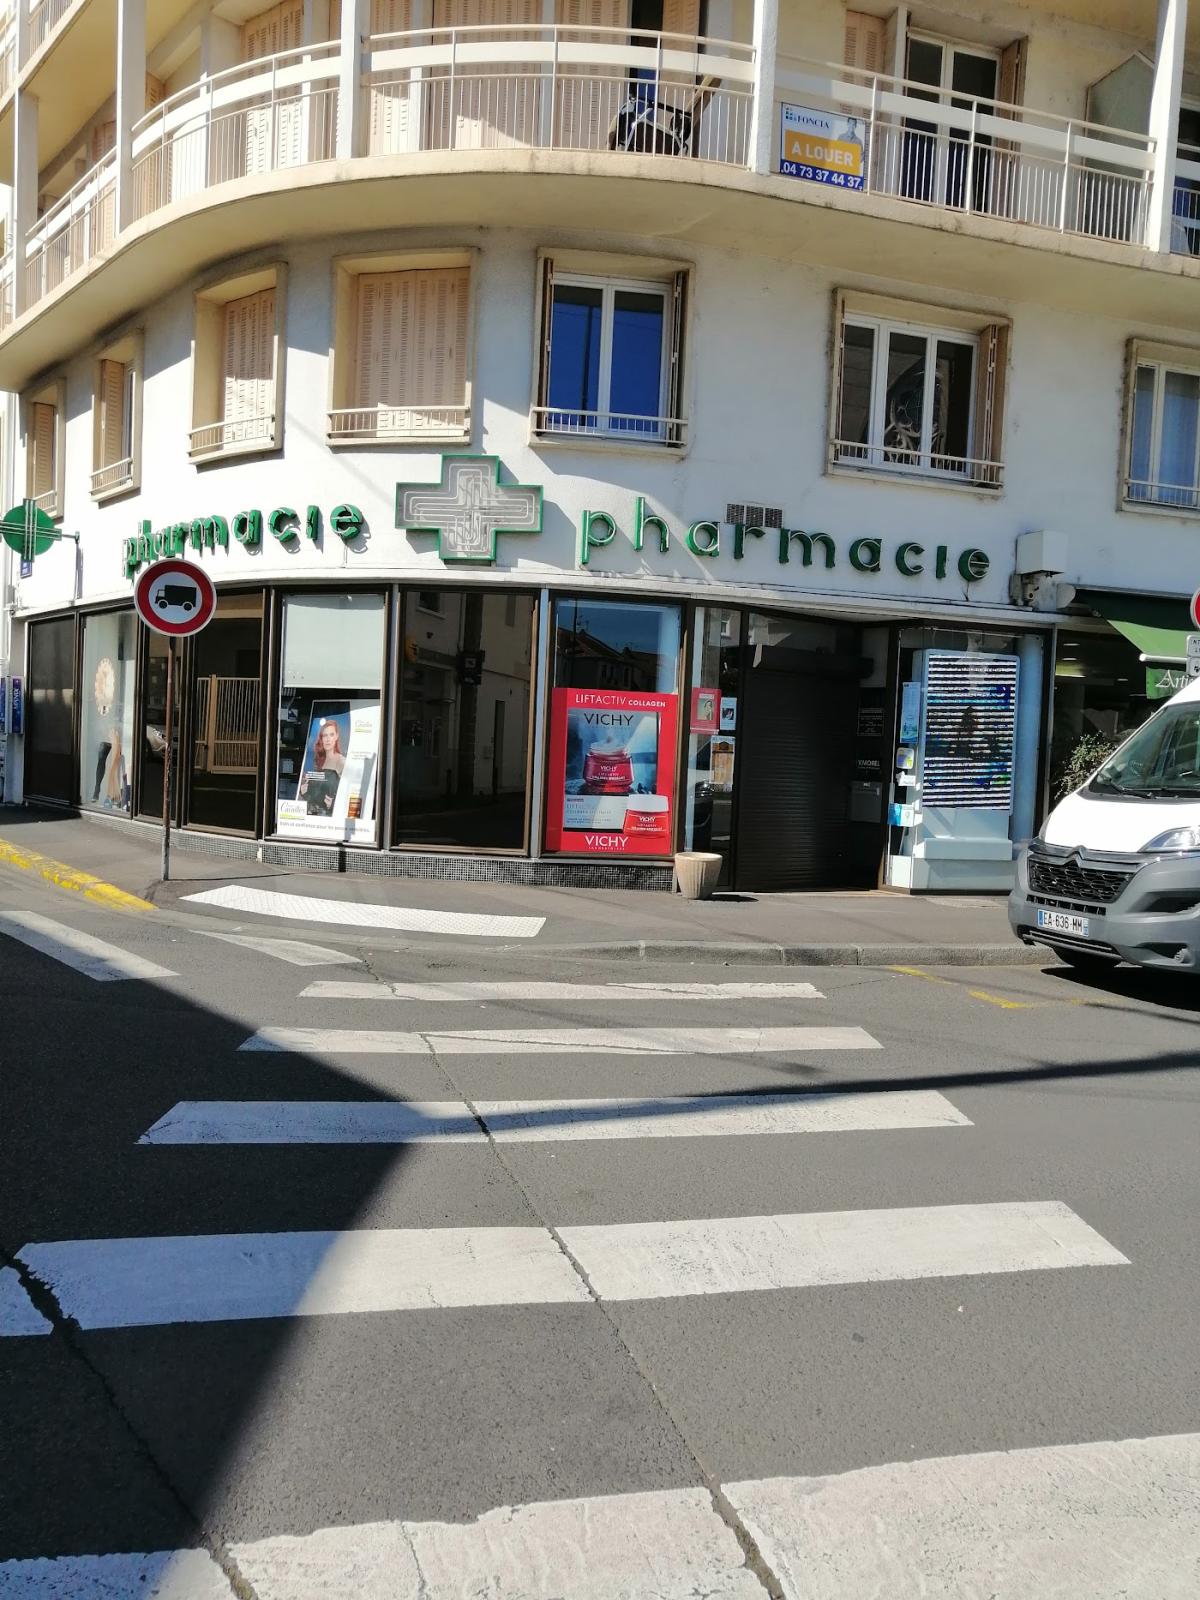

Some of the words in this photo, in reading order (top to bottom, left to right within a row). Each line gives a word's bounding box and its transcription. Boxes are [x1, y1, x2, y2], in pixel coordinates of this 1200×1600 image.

[797, 115, 829, 129] FONCIA
[792, 141, 802, 156] A
[806, 143, 853, 166] LOUER
[800, 165, 813, 178] 73
[815, 169, 829, 182] 37
[831, 173, 845, 185] 44
[122, 503, 363, 579] pharmacie
[581, 496, 991, 583] pharmacie
[575, 694, 627, 705] LIFTACTIV
[628, 700, 666, 708] COLLAGEN
[584, 713, 634, 726] VICHY
[585, 835, 629, 847] VICHY
